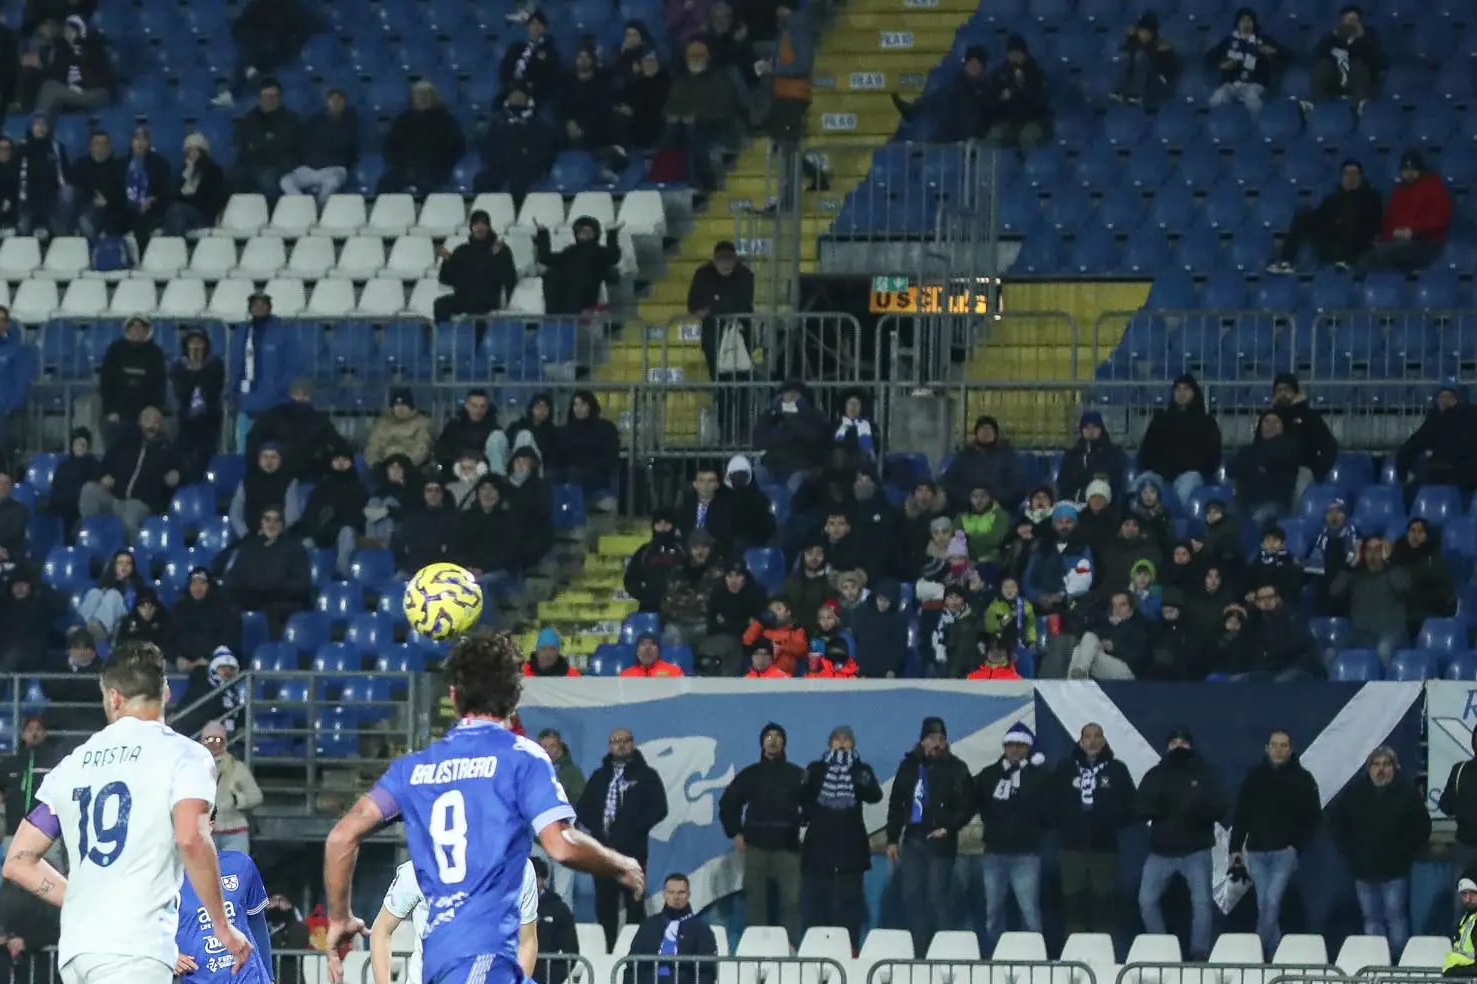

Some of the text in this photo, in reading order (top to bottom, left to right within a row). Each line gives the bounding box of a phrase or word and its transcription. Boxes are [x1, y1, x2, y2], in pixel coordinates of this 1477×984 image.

[81, 745, 142, 769] PRESTIA
[410, 756, 498, 786] BALESTRERO
[71, 781, 133, 867] 19
[429, 789, 468, 884] 8
[196, 901, 237, 924] aa
